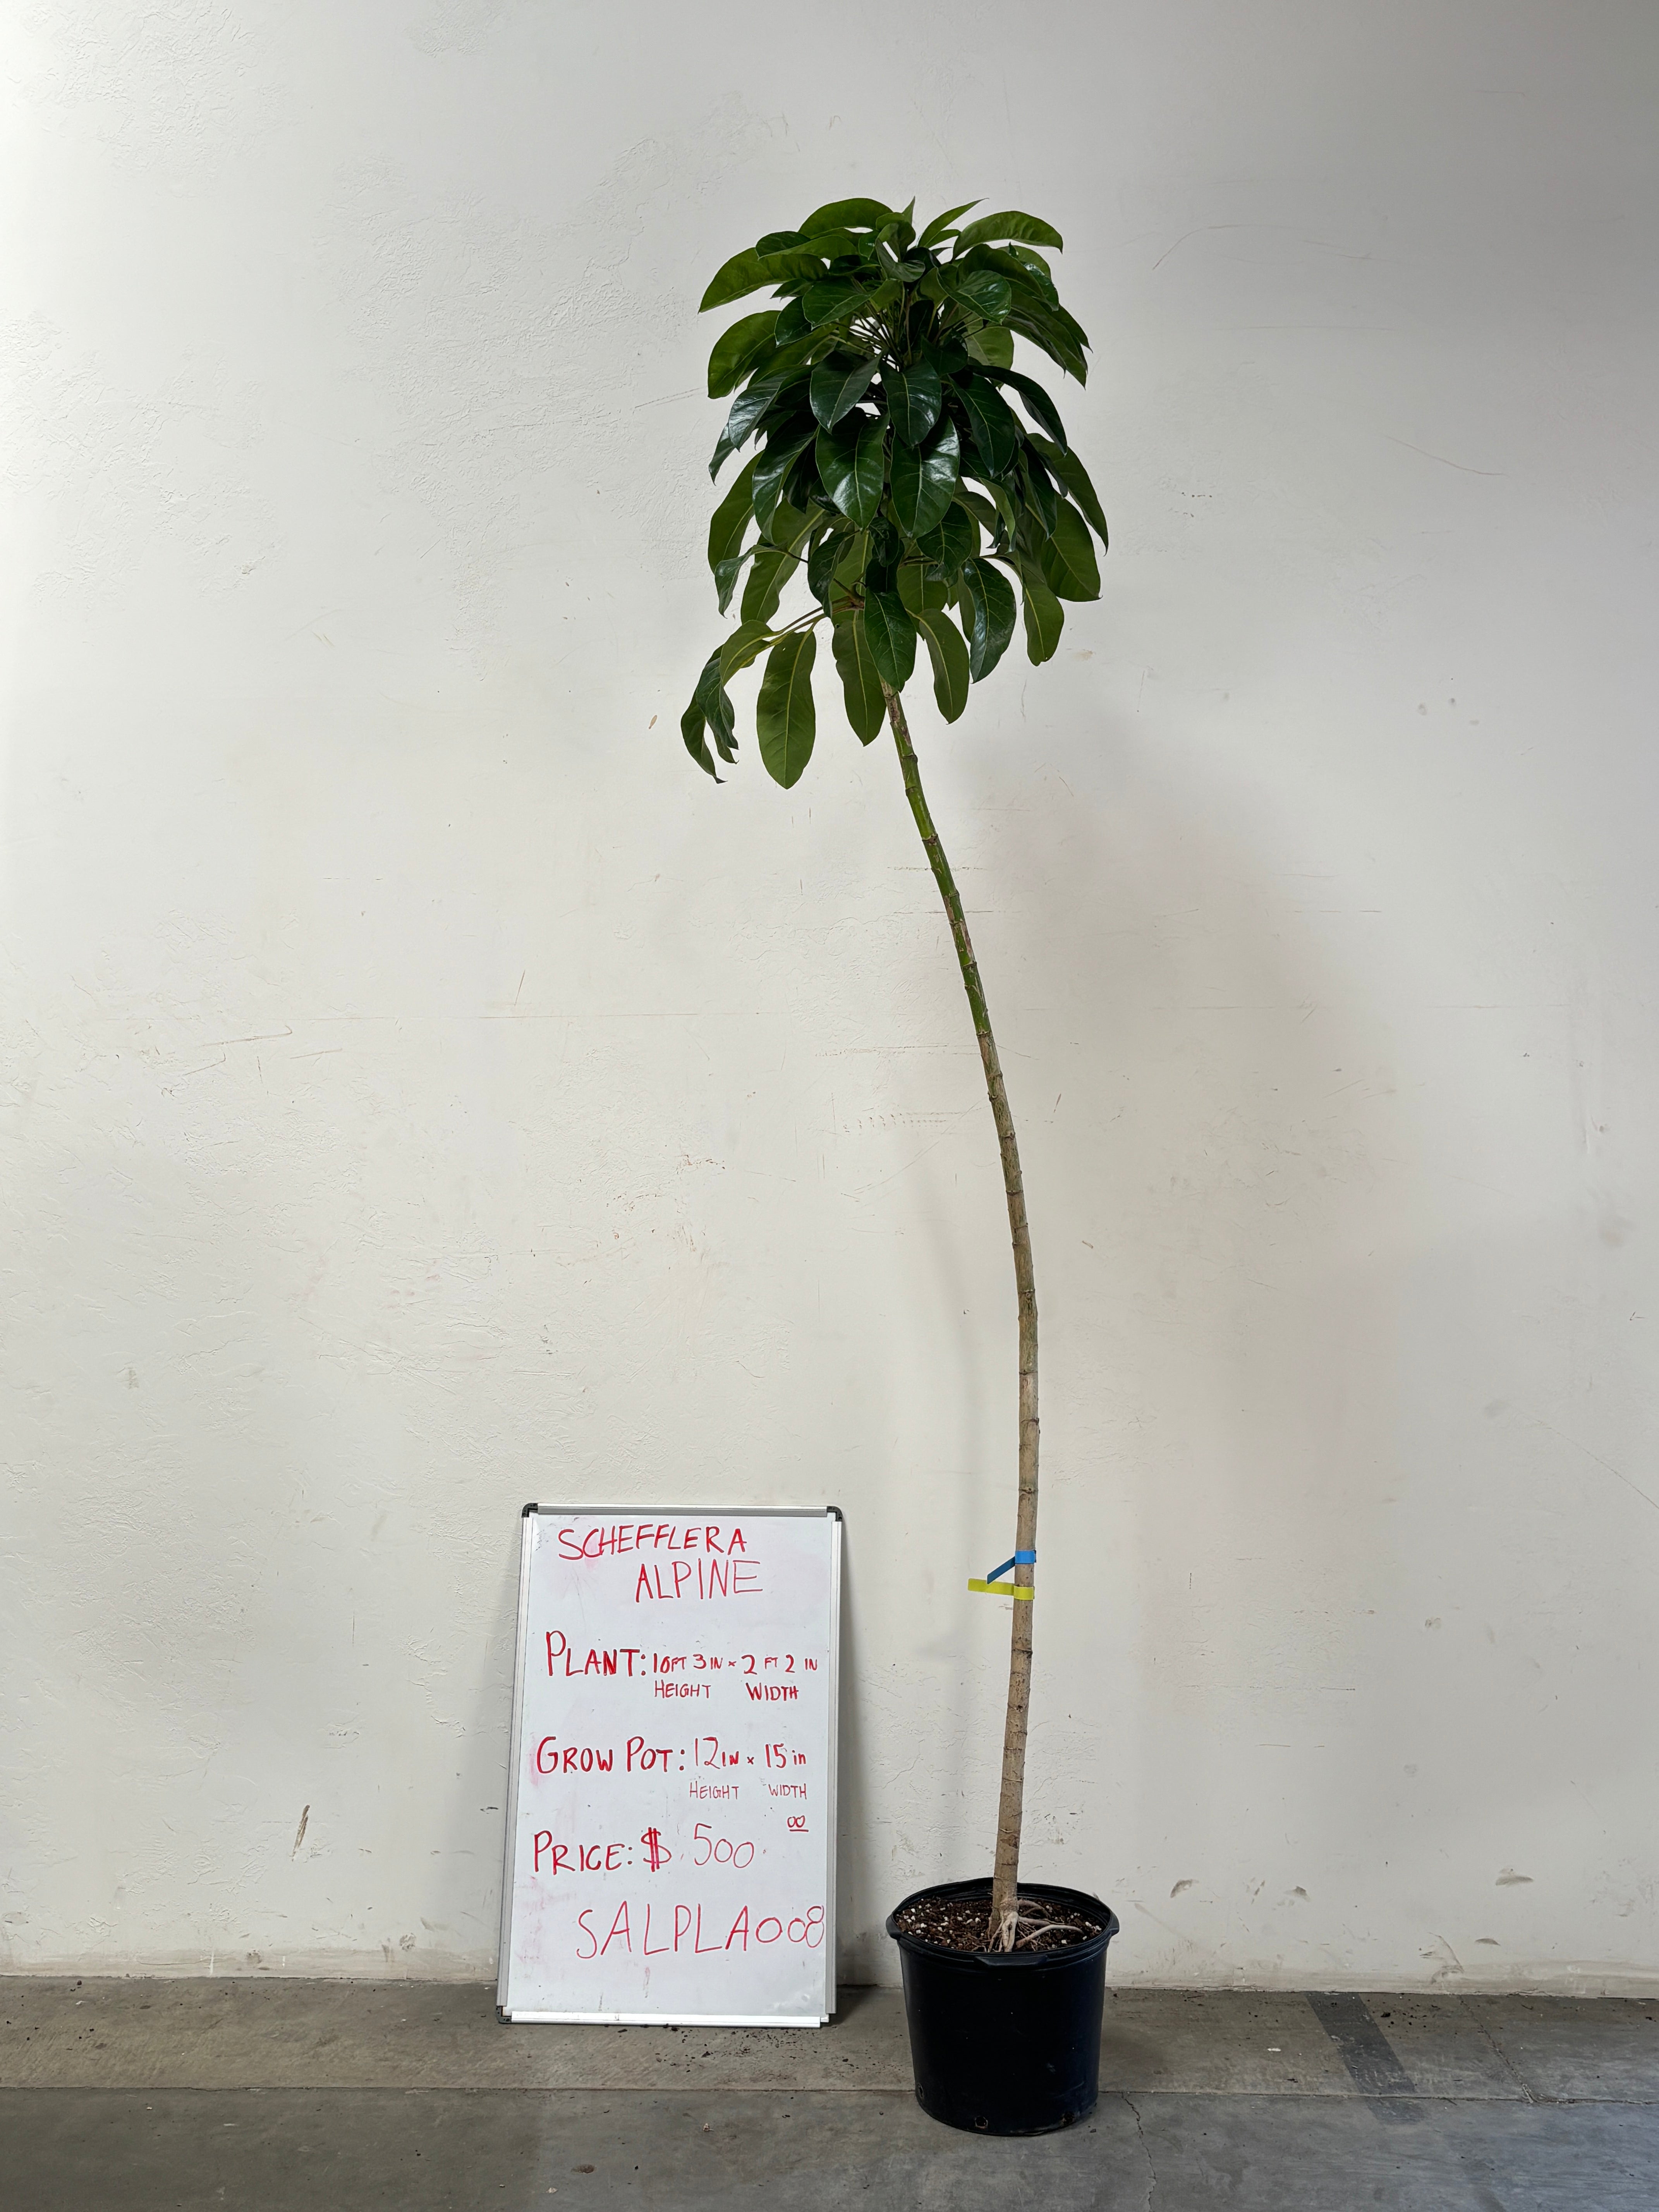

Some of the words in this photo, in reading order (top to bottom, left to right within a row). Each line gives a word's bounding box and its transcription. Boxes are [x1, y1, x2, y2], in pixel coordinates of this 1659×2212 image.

[558, 1523, 747, 1560] SCHEFFLERA
[635, 1558, 763, 1603] ALPINE
[545, 1630, 647, 1677] PLANT:
[654, 1679, 711, 1699] HEIGHT
[745, 1682, 799, 1701] WIDTH
[536, 1736, 613, 1774] GROW
[626, 1736, 685, 1772] POT:
[689, 1780, 740, 1800] HEIGHT
[768, 1783, 807, 1800] WIDTH
[534, 1829, 633, 1875] PRICE:
[576, 1900, 824, 1960] SALPLA008
